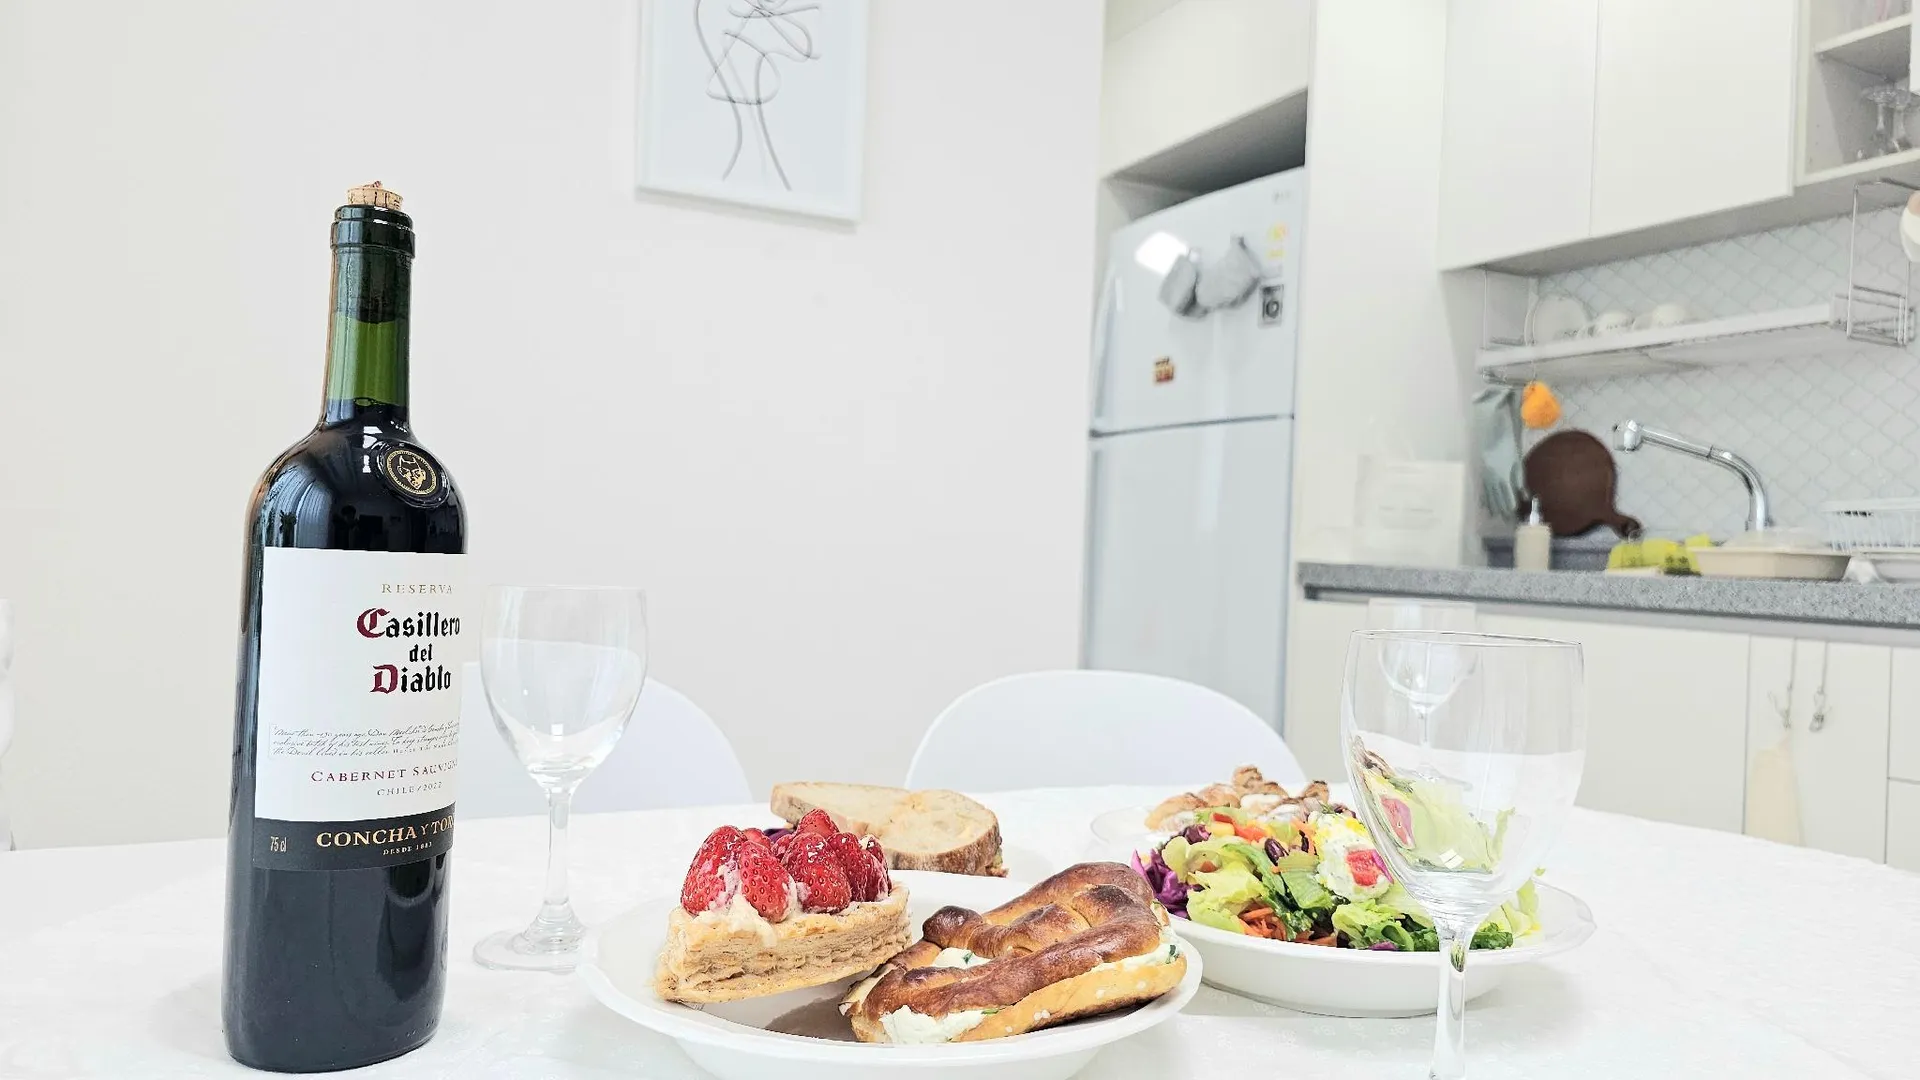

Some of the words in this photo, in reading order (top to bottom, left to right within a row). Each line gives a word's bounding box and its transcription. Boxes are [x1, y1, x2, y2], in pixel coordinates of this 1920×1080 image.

[381, 583, 453, 594] RESERVA
[356, 608, 460, 639] Casillero
[409, 643, 433, 662] del
[370, 664, 452, 694] Diablo
[311, 769, 407, 782] CABERNET
[270, 836, 280, 852] 75
[316, 826, 418, 848] CONCHA
[420, 823, 430, 836] Y
[382, 845, 413, 856] DESDE
